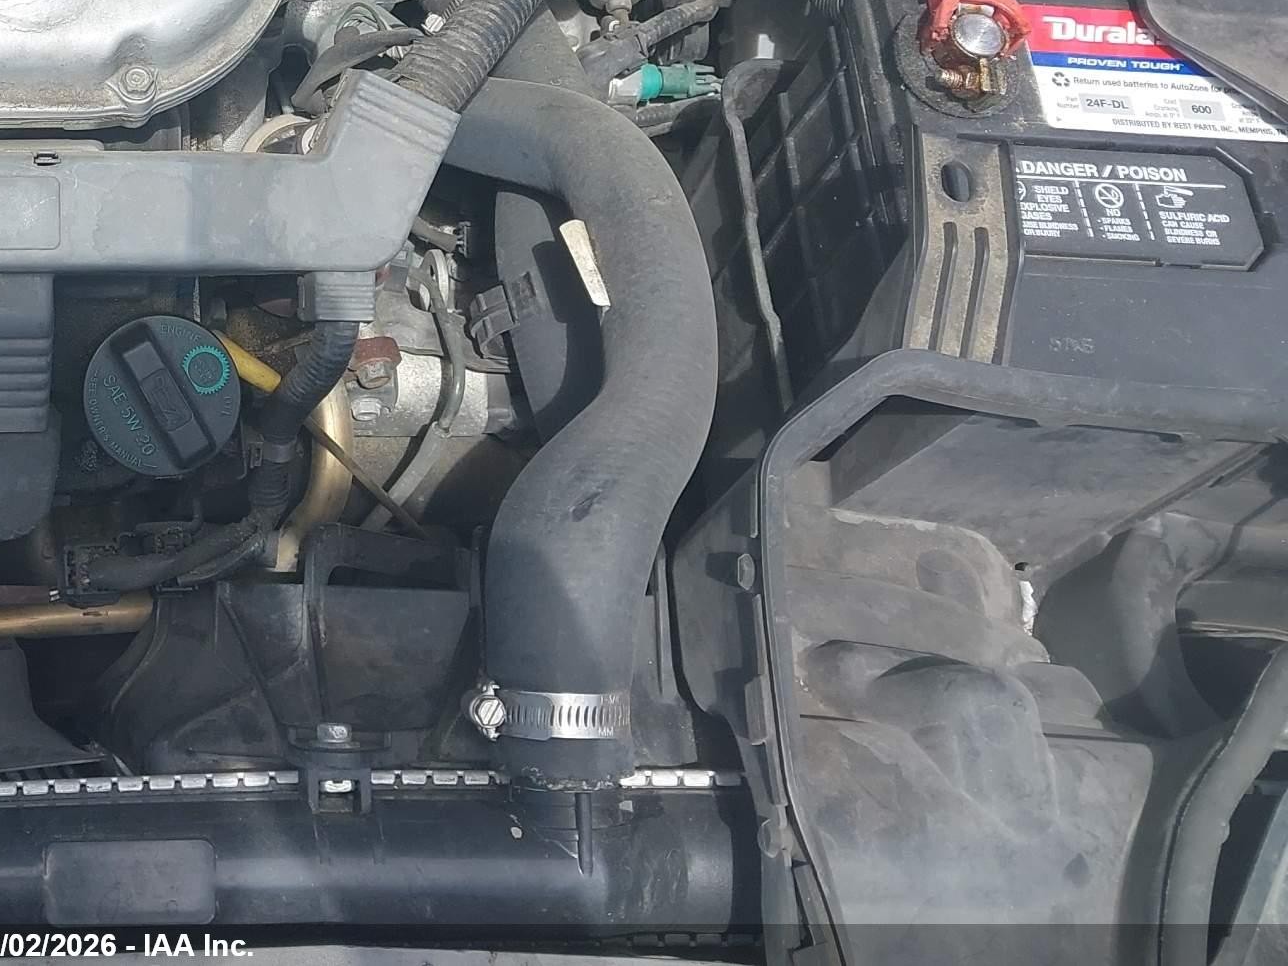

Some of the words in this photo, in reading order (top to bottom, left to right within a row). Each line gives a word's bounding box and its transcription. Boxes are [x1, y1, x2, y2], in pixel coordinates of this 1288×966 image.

[1042, 16, 1161, 46] Durala
[1067, 56, 1127, 69] PROVEN
[1131, 60, 1181, 72] TOUGH
[1073, 77, 1100, 86] Return
[1103, 79, 1121, 87] used
[1124, 80, 1159, 89] batteries
[1161, 82, 1169, 90] to
[1171, 83, 1209, 92] AutoZone
[1086, 98, 1129, 110] 24F-DL
[1191, 104, 1212, 114] 600
[1112, 118, 1160, 128] DISTRIBUTED
[1162, 121, 1171, 129] BY
[1021, 160, 1099, 177] DANGER
[1102, 165, 1113, 177] /
[1116, 165, 1188, 182] POISON
[1034, 185, 1069, 195] SHIELD
[1037, 194, 1063, 203] EYES
[1105, 208, 1121, 217] NO
[1159, 211, 1206, 222] SULFURIC
[1208, 214, 1230, 223] ACID
[1162, 220, 1179, 228] CAN
[1180, 221, 1205, 229] CAUSE
[104, 373, 127, 406] SAE
